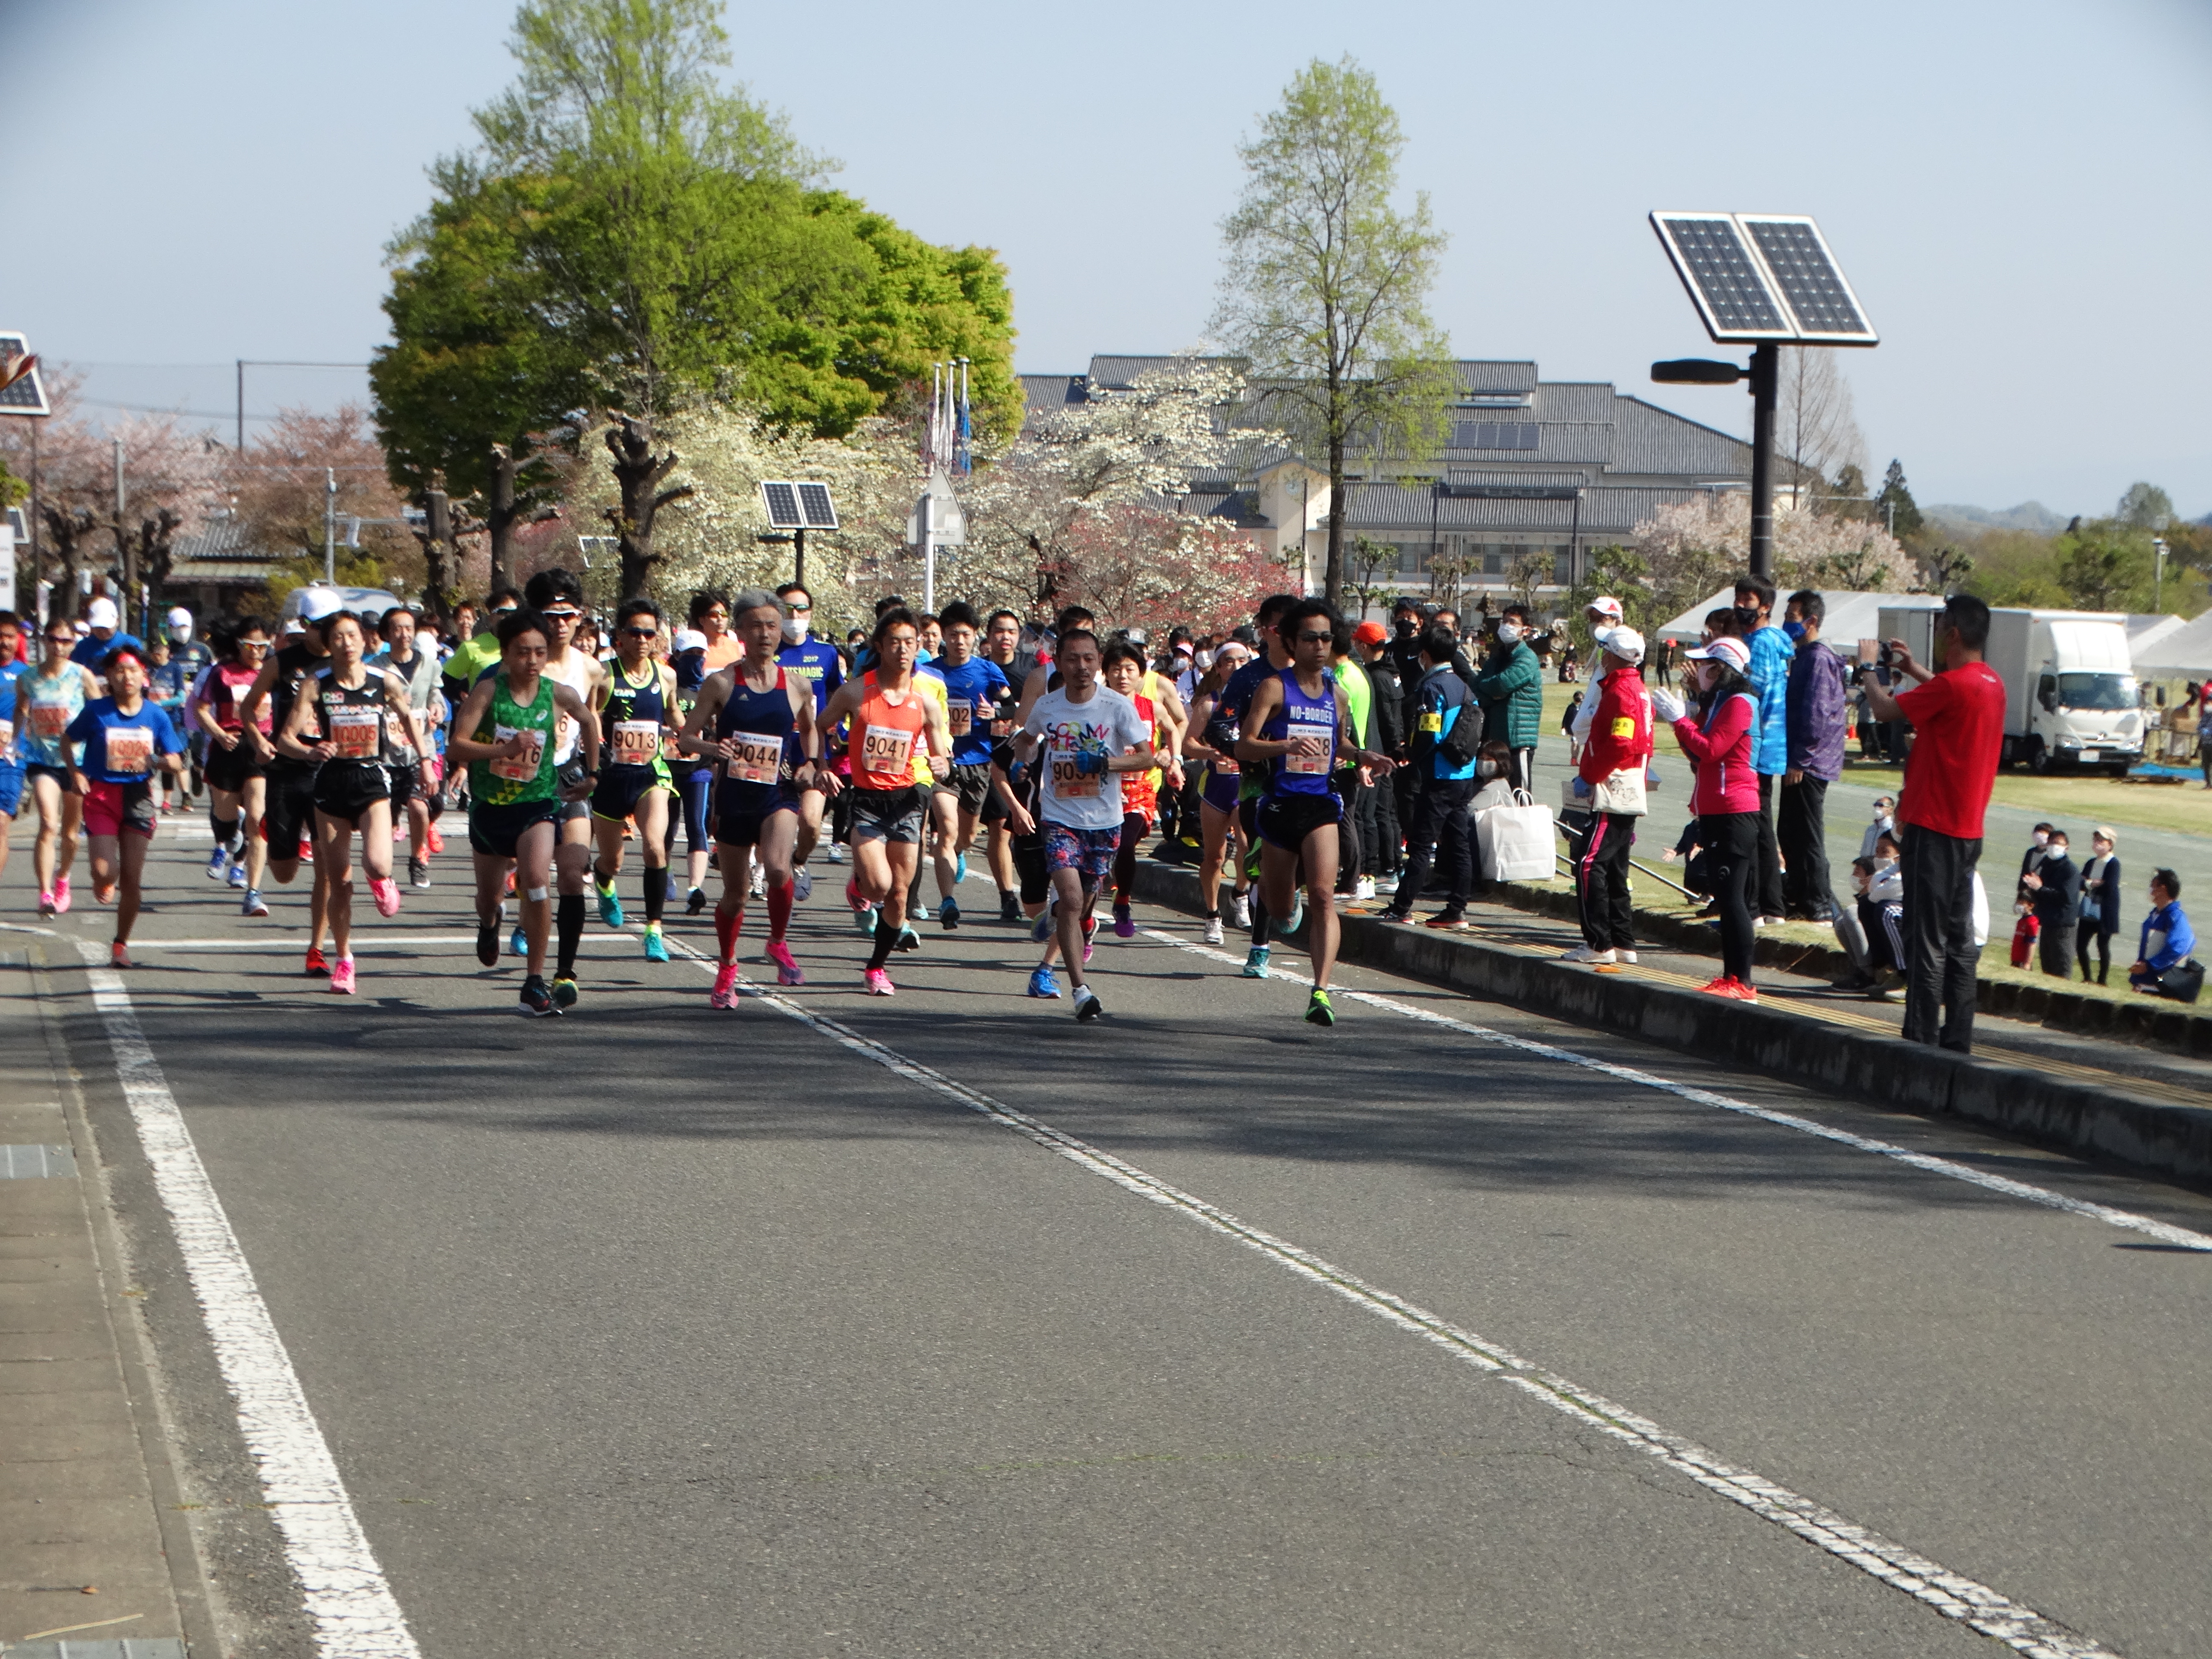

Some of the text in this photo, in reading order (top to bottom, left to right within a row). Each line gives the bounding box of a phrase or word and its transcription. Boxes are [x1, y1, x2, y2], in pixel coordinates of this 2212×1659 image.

[803, 655, 819, 663] 2017
[949, 708, 969, 722] 02
[1289, 705, 1333, 725] NO-BORDER
[333, 725, 376, 742] 10005
[614, 731, 655, 748] 9013
[732, 742, 777, 766] 9044
[866, 735, 907, 757] 9041
